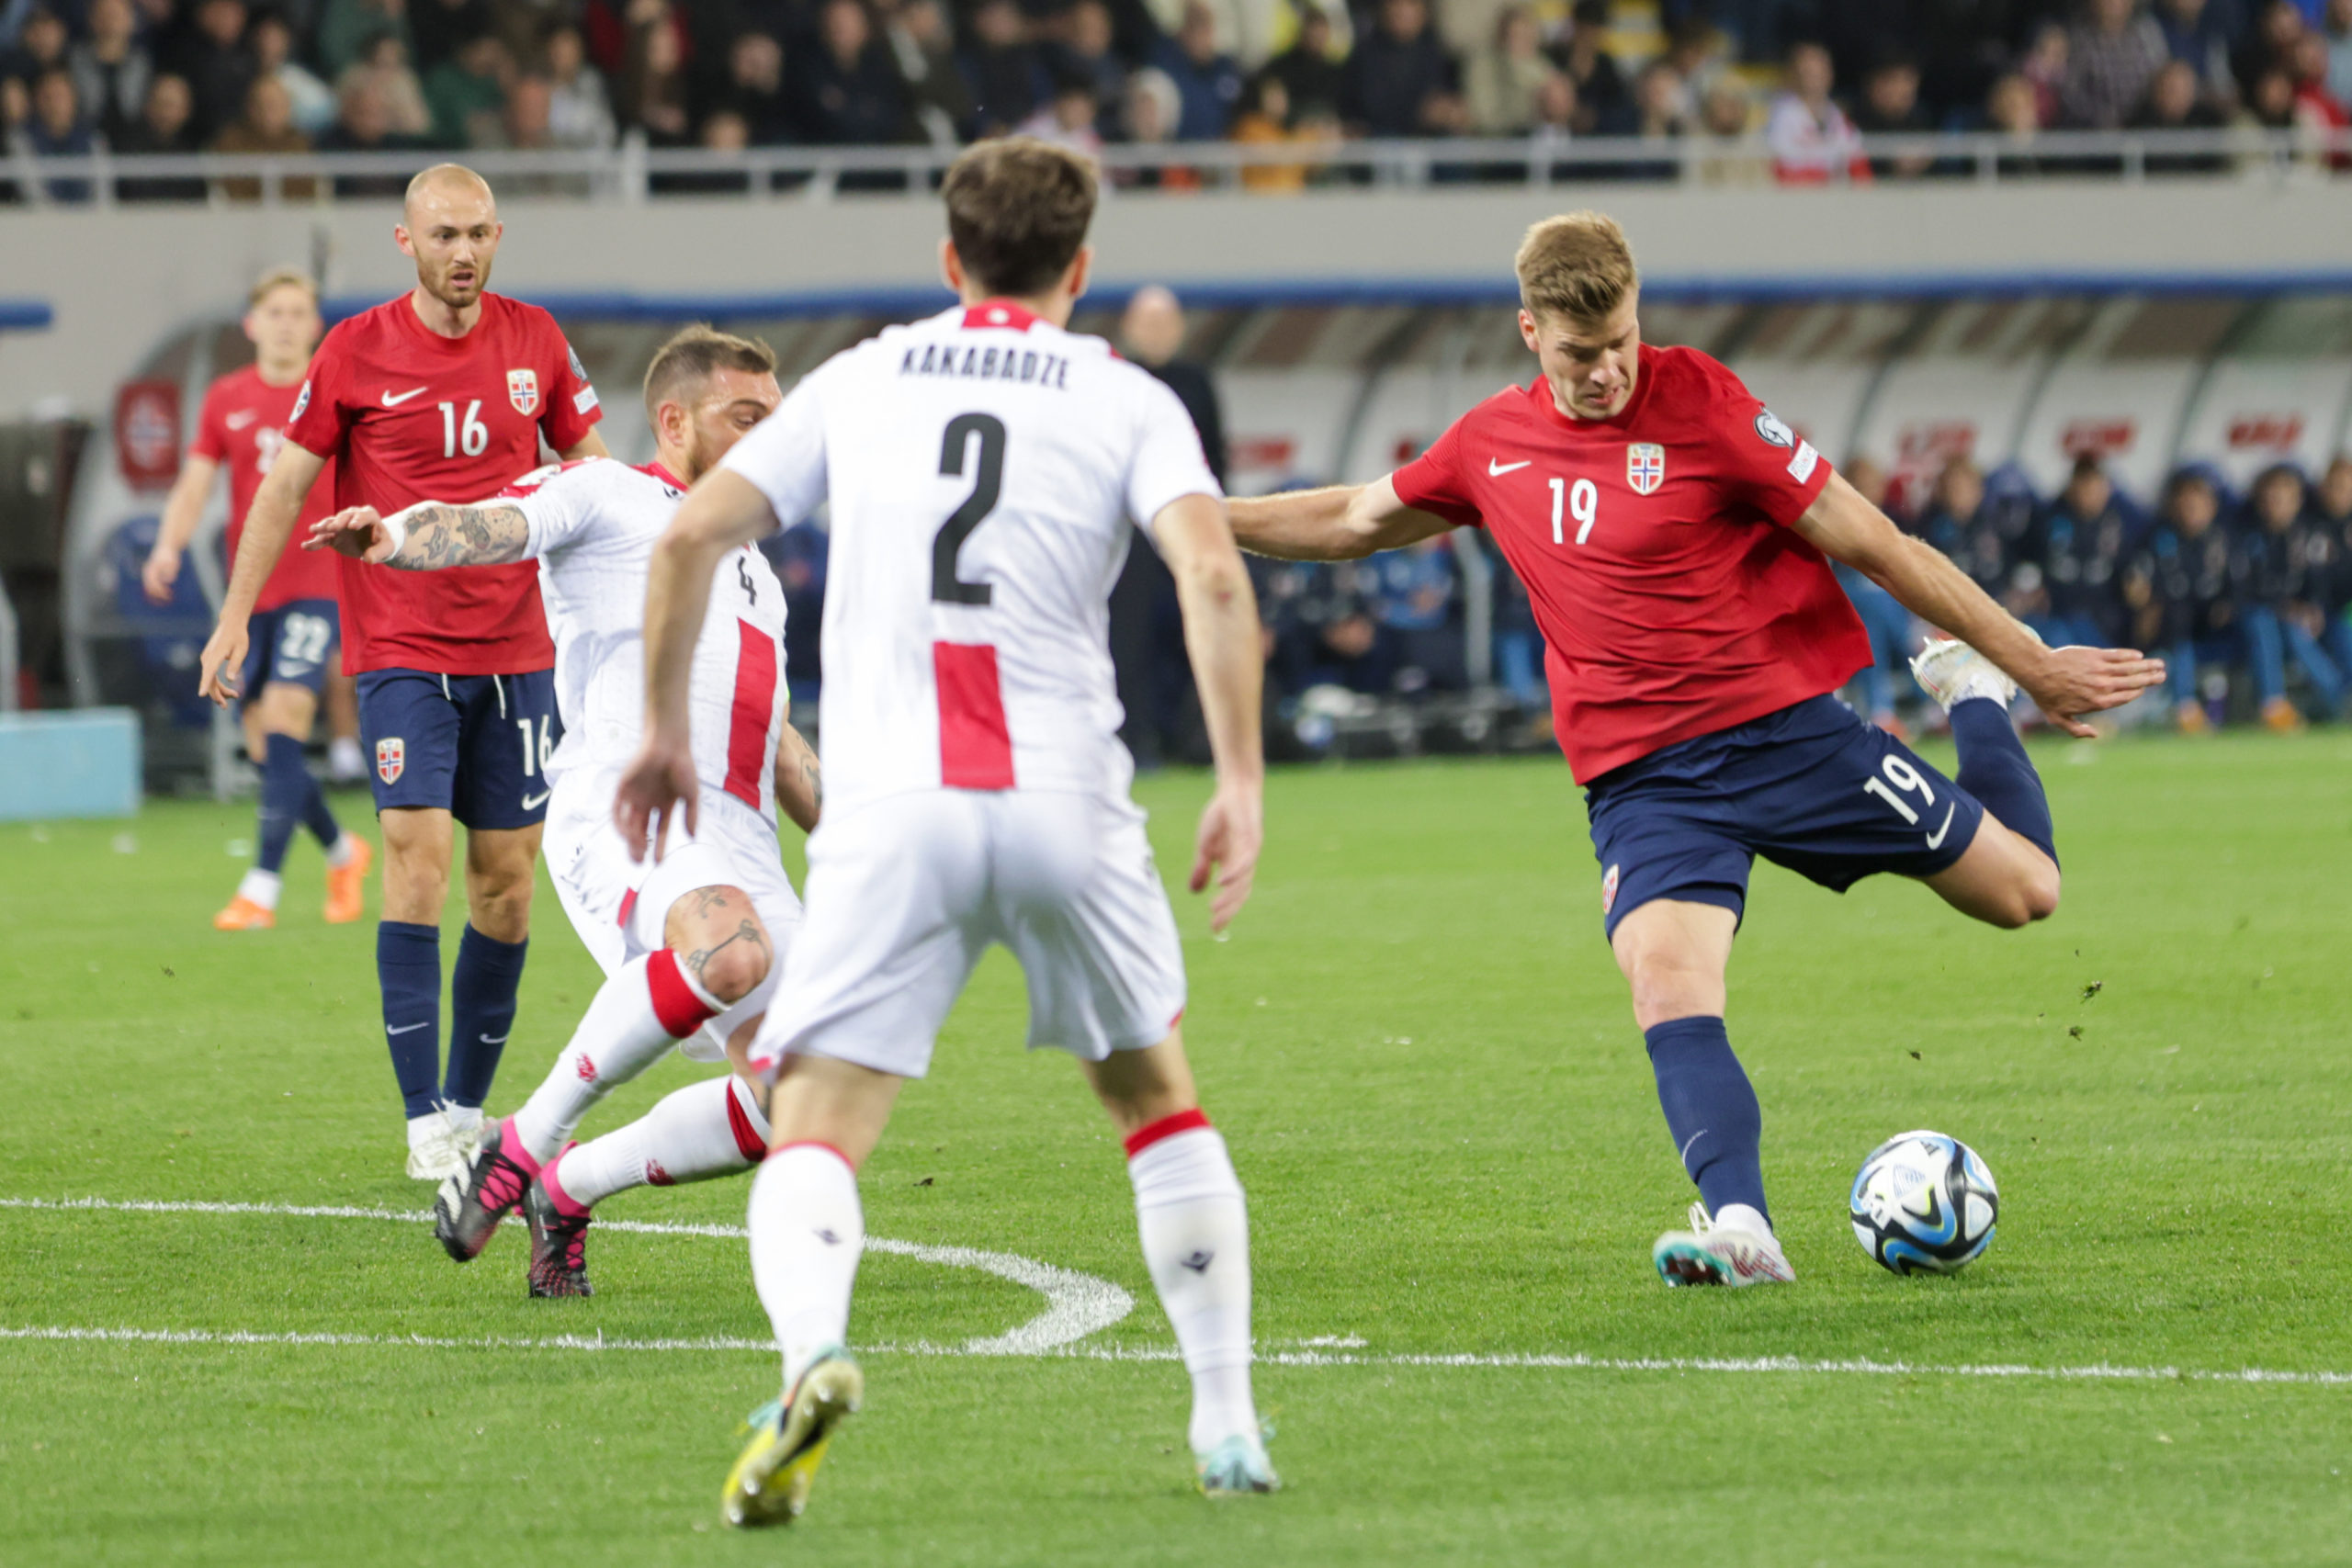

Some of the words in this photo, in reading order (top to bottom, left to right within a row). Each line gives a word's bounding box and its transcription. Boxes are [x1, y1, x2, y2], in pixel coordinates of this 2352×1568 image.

[900, 344, 1069, 389] KAKABADZE
[438, 399, 489, 458] 16
[931, 412, 1006, 606] 2
[1548, 477, 1598, 545] 19
[738, 555, 757, 606] 4
[280, 611, 332, 664] 22
[1863, 753, 1936, 826] 19
